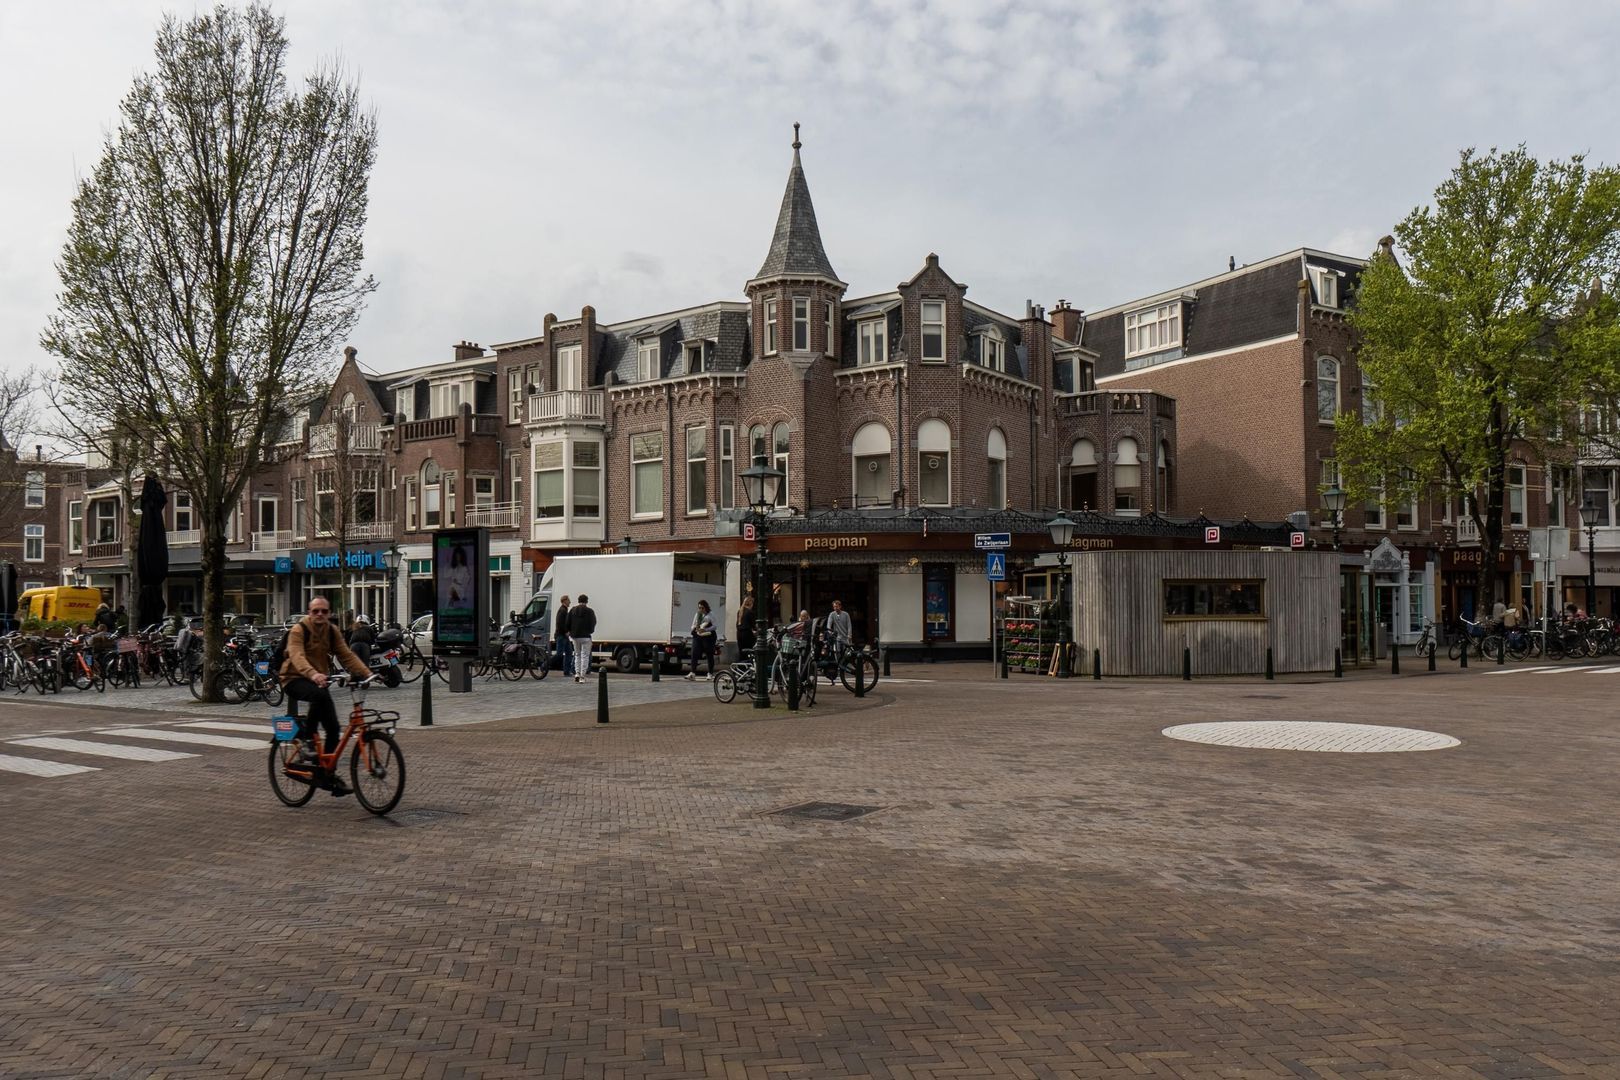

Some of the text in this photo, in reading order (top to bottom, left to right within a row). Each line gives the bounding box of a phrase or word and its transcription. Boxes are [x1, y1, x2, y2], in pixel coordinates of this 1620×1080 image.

[804, 537, 867, 550] paagman
[1064, 538, 1113, 550] aagman
[305, 552, 339, 568] Albert
[1453, 551, 1504, 564] paagn
